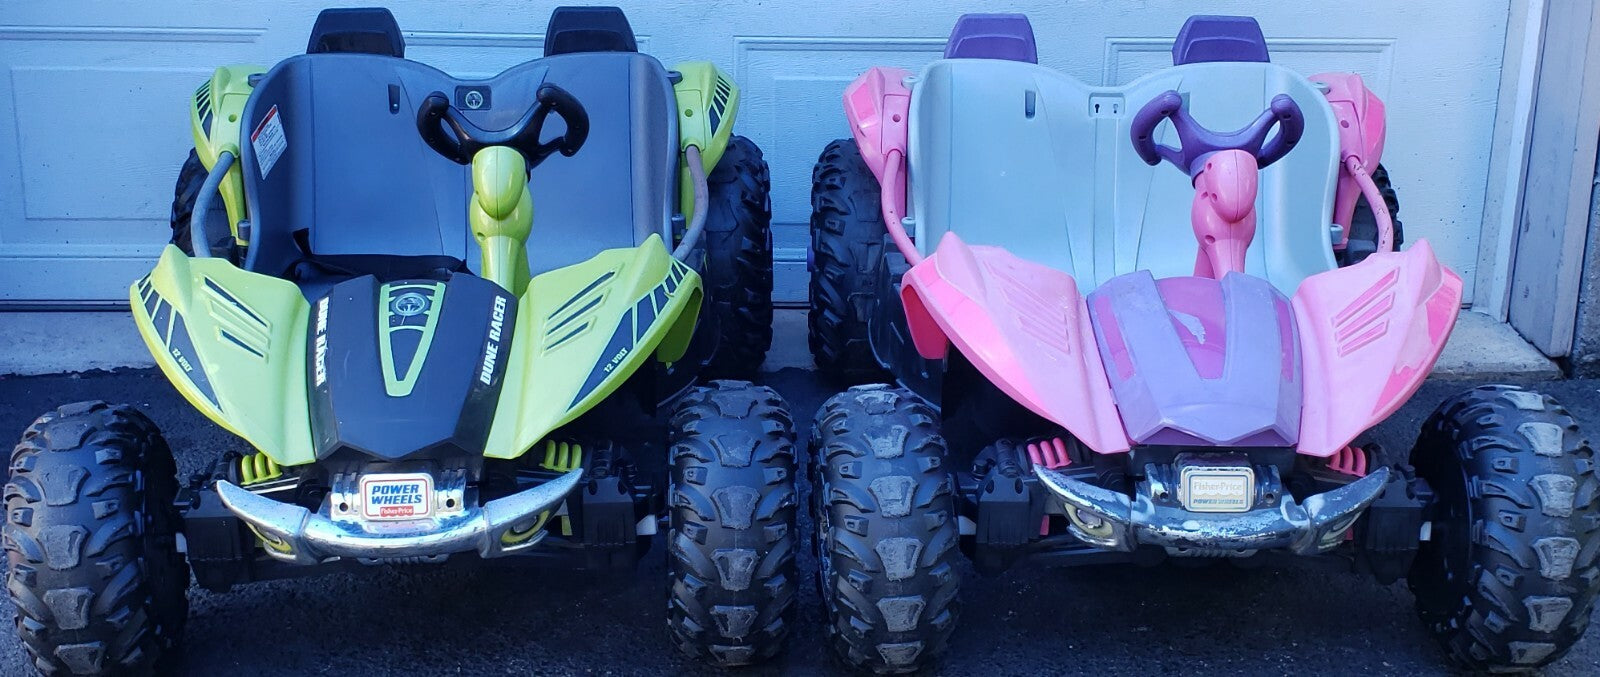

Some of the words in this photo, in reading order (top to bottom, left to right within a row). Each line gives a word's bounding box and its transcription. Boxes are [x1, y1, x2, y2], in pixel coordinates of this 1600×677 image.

[489, 295, 507, 342] RACER
[172, 348, 181, 358] 12
[178, 356, 193, 372] VOLT
[480, 341, 499, 386] DUNE
[603, 363, 615, 373] 12
[611, 347, 628, 364] VOLT
[372, 484, 419, 495] POWER
[1193, 481, 1242, 491] Fisher-Price
[371, 494, 422, 505] WHEELS
